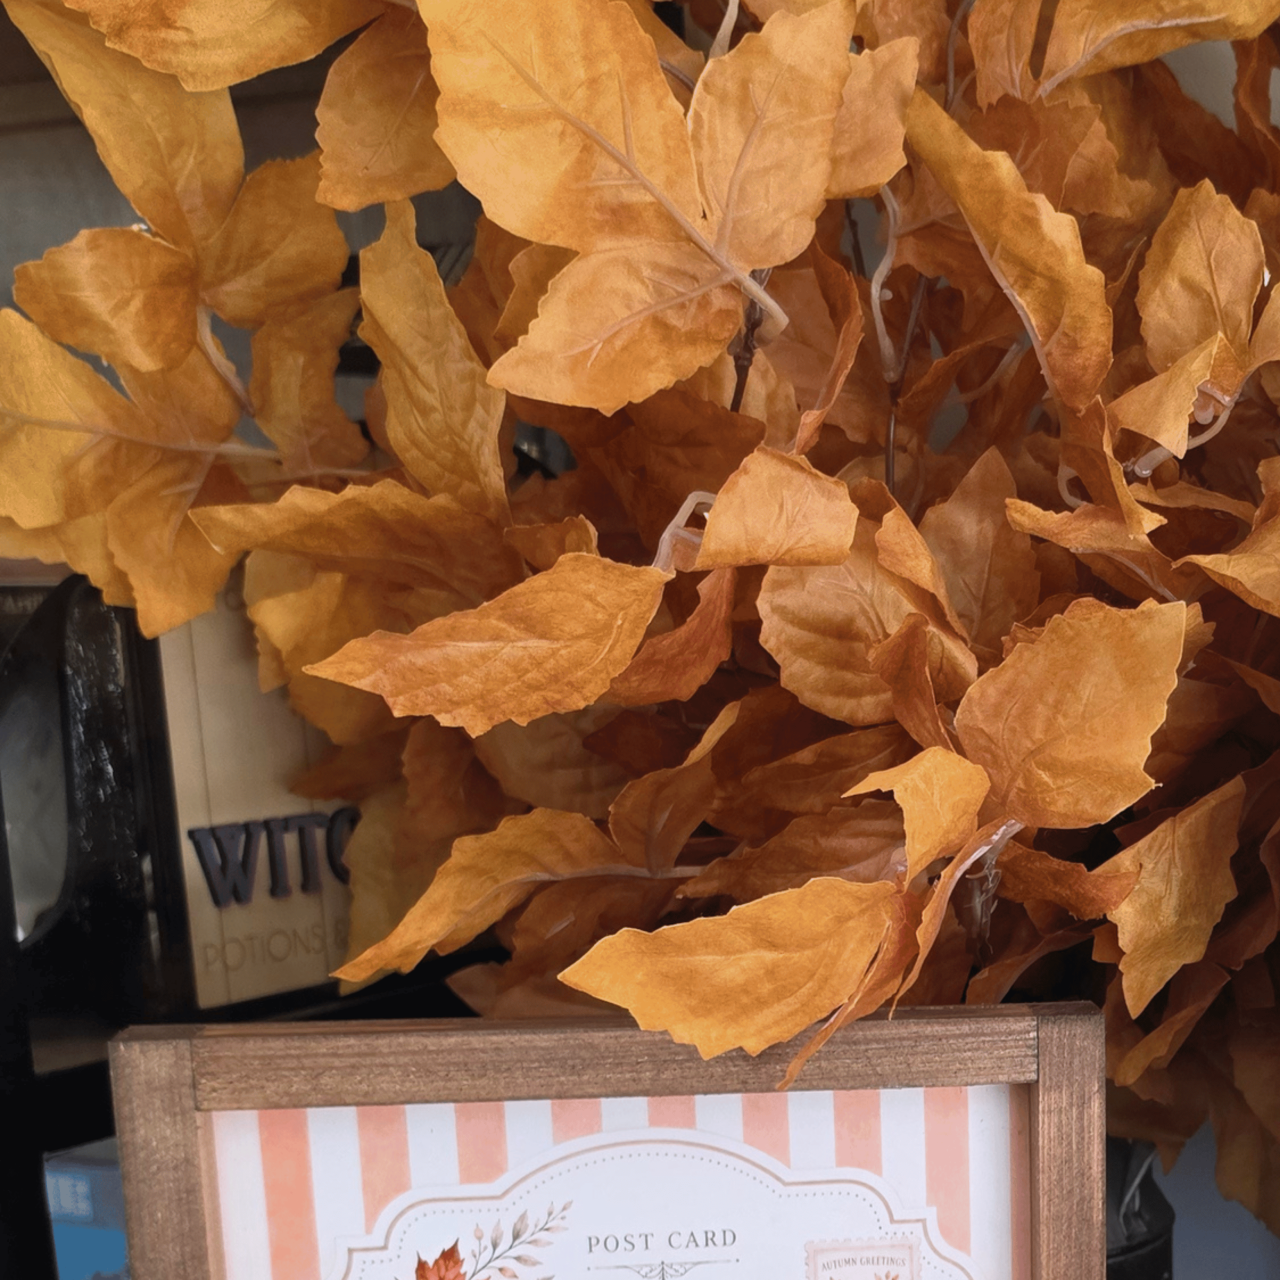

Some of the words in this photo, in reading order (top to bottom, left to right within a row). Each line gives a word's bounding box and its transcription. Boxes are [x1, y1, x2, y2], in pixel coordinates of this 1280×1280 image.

[203, 925, 326, 974] POTIONS
[587, 1233, 655, 1254] POST
[668, 1228, 737, 1250] CARD
[822, 1257, 857, 1272] AUTUMN
[860, 1256, 906, 1267] GREETINGS
